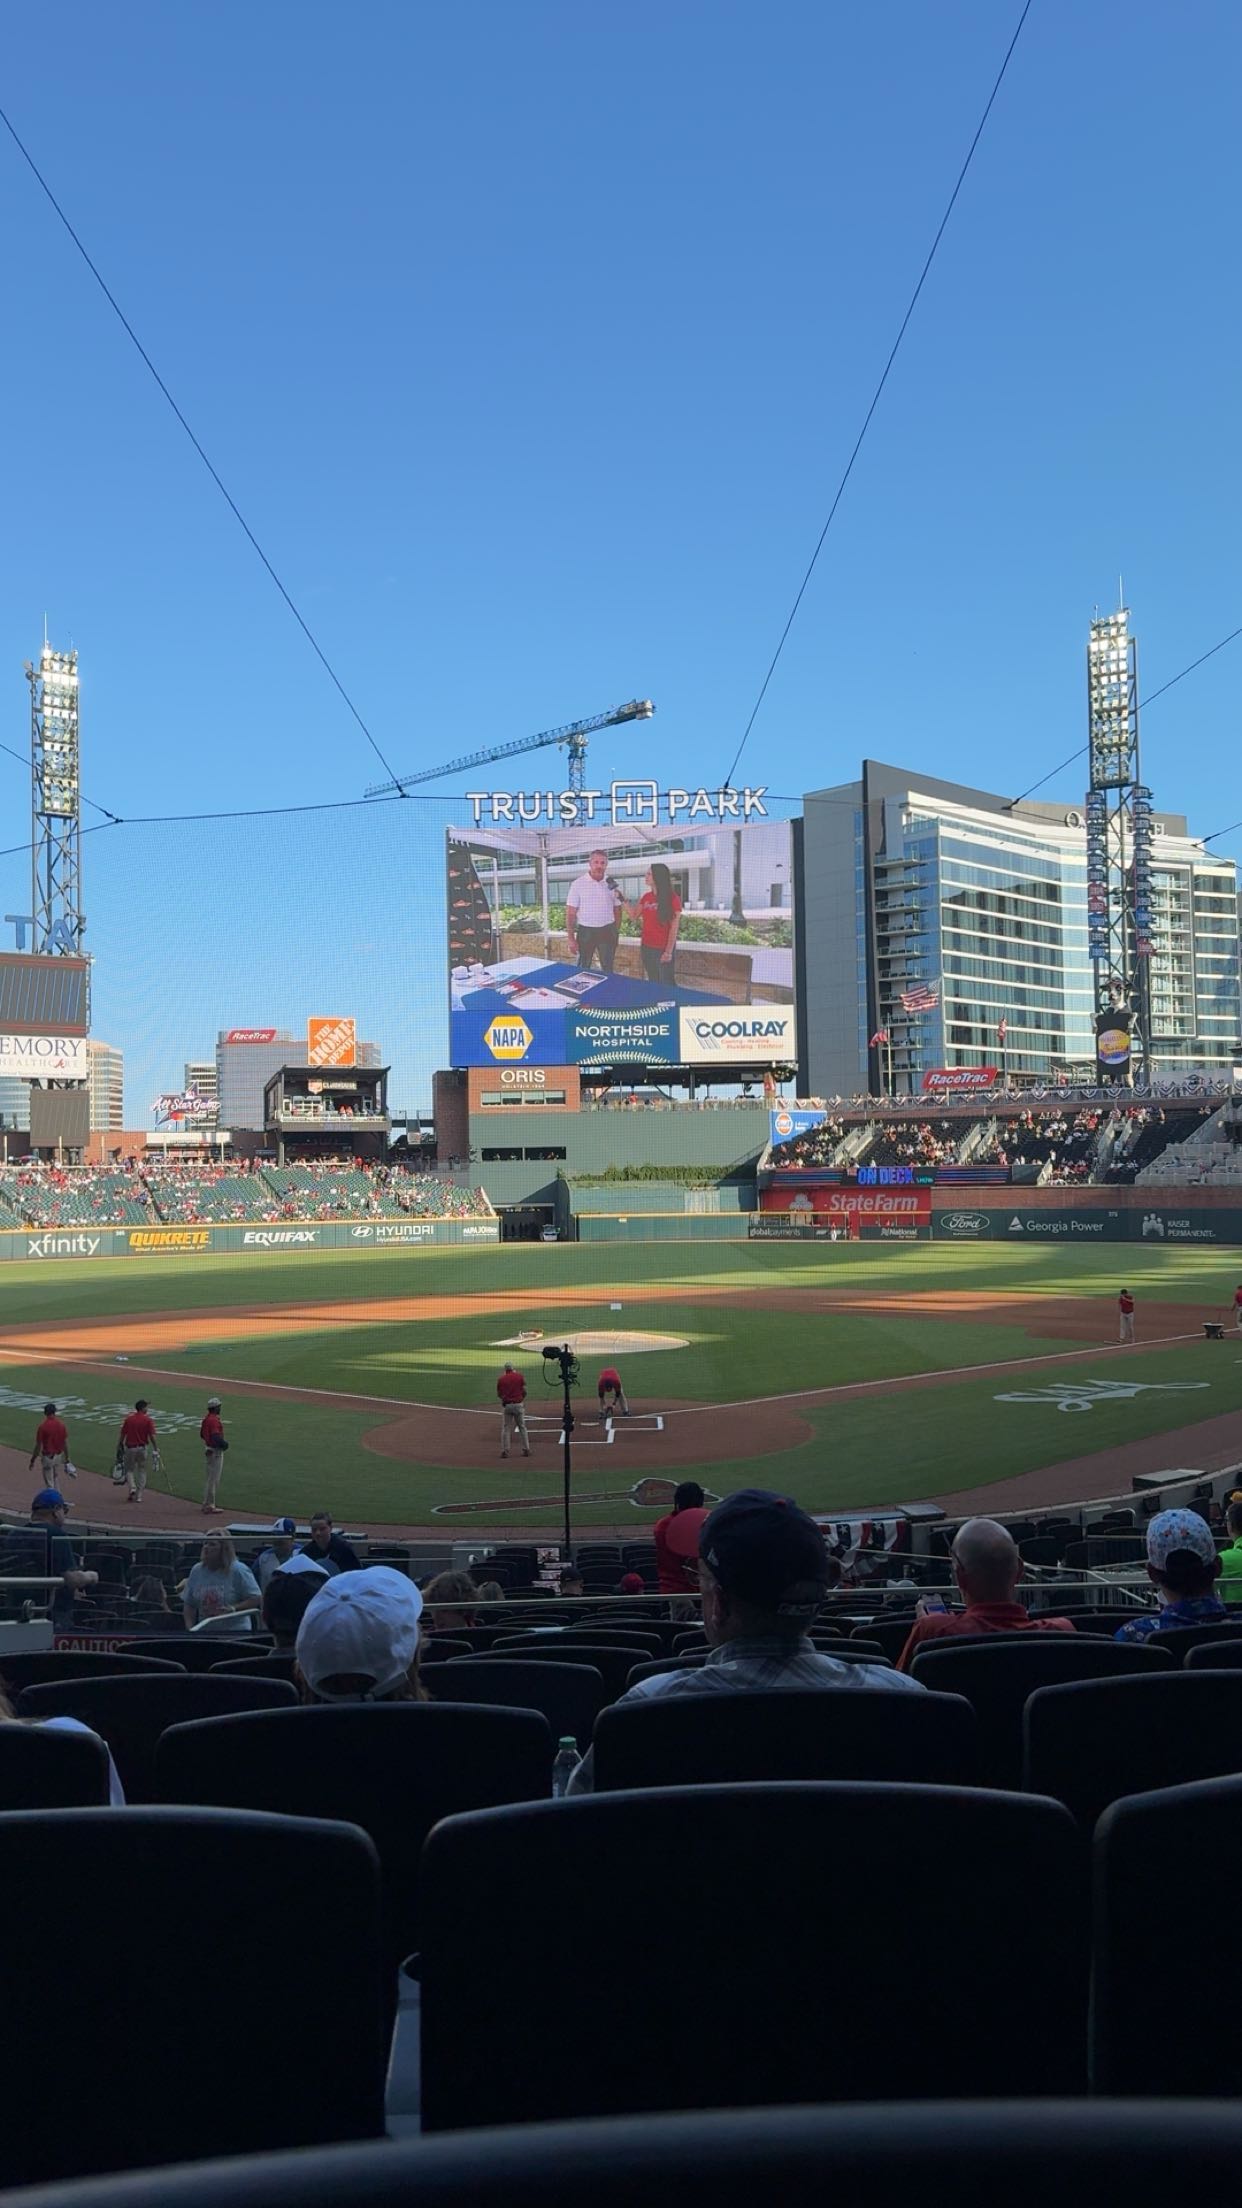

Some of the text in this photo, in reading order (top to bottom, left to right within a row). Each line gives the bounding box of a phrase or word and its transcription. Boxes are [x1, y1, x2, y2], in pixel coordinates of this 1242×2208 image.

[465, 786, 769, 821] TRUIST PARK
[232, 1031, 271, 1041] RaceTrac
[314, 1024, 333, 1041] THE
[575, 1024, 670, 1037] NORTHSIDE
[695, 1020, 789, 1038] COOLRAY
[309, 1018, 355, 1064] HOME
[491, 1028, 526, 1047] NAPA
[592, 1036, 653, 1047] HOSPITAL
[0, 1037, 82, 1057] EMORY
[328, 1036, 355, 1064] DEPOT
[501, 1069, 545, 1083] ORIS
[928, 1072, 989, 1086] RaceTrac
[857, 1167, 877, 1185] ON
[879, 1167, 914, 1184] DECK
[949, 1214, 982, 1229] Ford
[1026, 1220, 1104, 1234] Georgia Power
[1167, 1220, 1190, 1228] KAISER
[376, 1225, 434, 1236] HYUNDAI
[28, 1233, 100, 1258] xfinity
[129, 1231, 209, 1247] QUIKRETE
[244, 1231, 316, 1247] EQUIFAX
